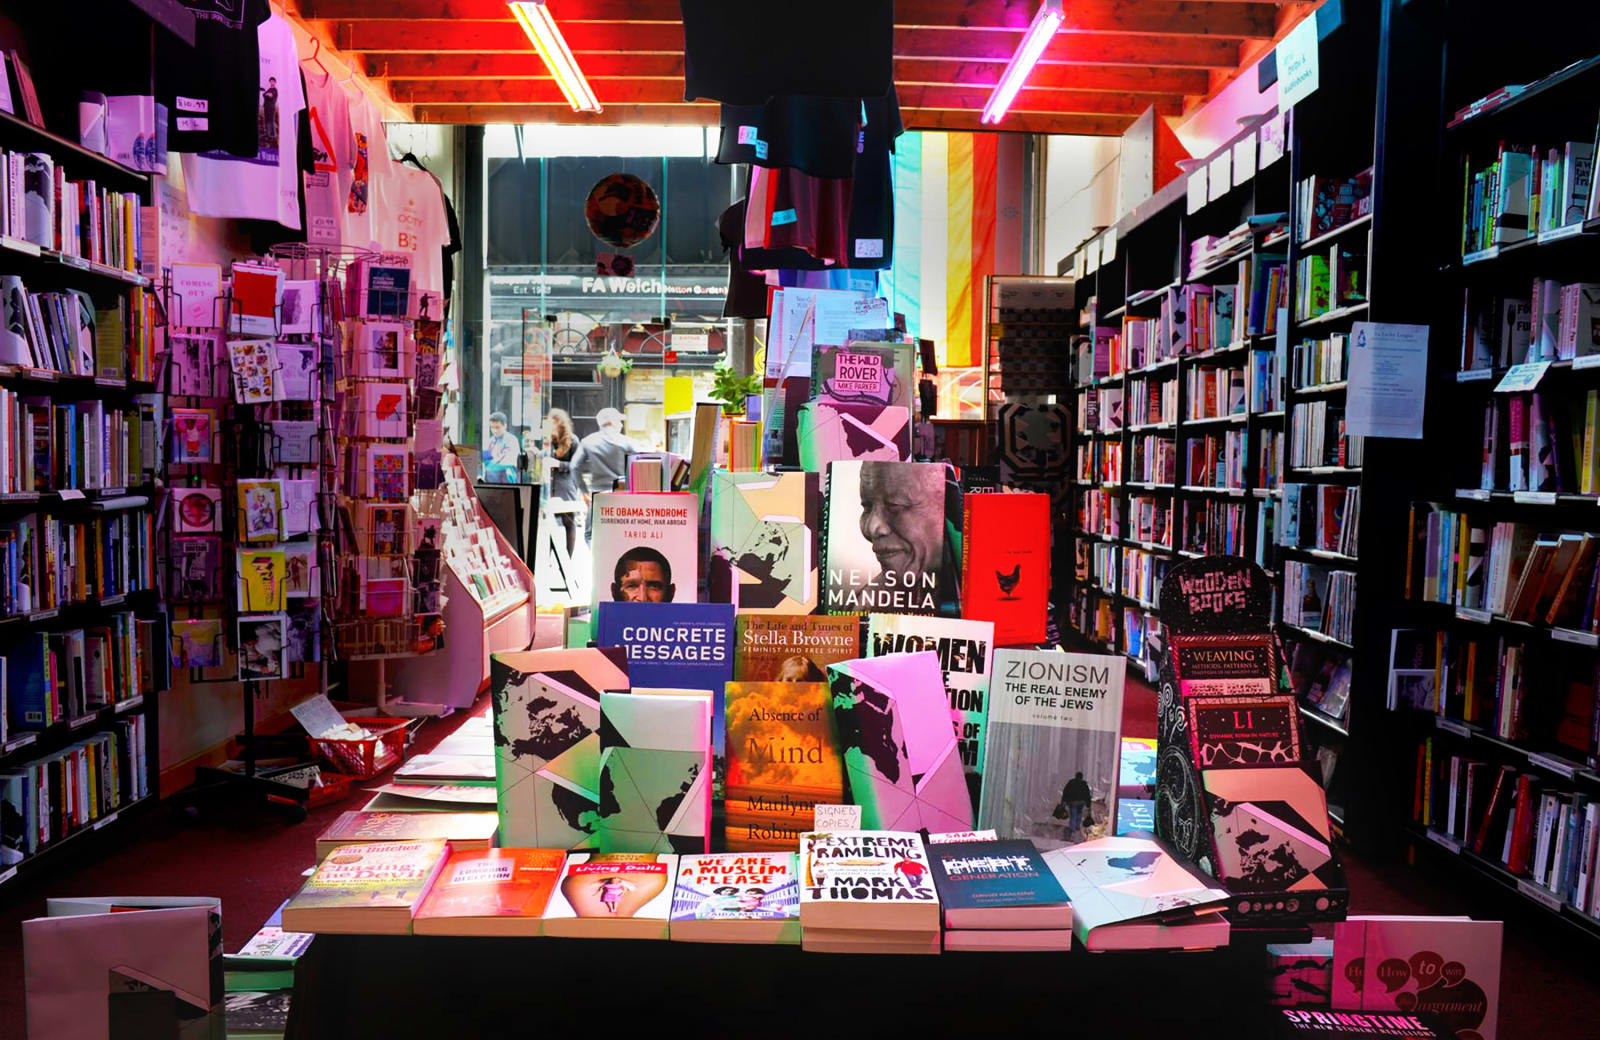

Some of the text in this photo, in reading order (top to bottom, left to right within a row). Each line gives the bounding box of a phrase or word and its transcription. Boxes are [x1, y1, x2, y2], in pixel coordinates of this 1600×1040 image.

[582, 277, 606, 293] FA
[609, 277, 662, 294] Welch
[838, 353, 879, 366] THE WILD
[839, 366, 877, 381] ROVER
[837, 382, 878, 391] MIKE PARKER
[600, 506, 688, 518] THE OBAMA SYNDROME
[624, 530, 663, 539] TARIQ ALI
[829, 569, 936, 589] NELSON
[1179, 569, 1252, 595] WOODEN
[828, 589, 936, 609] MANDELA
[1188, 591, 1246, 614] BOOKS
[745, 621, 765, 630] The
[791, 621, 807, 631] and
[811, 621, 841, 631] Times
[843, 623, 854, 631] of
[623, 627, 726, 643] CONCRETE
[743, 630, 854, 646] Stella Browne
[1193, 649, 1255, 662] WEAVING
[1006, 660, 1109, 685] ZIONISM
[1005, 682, 1107, 699] THE REAL ENEMY
[1015, 695, 1094, 711] OF THE JEWS
[748, 707, 823, 722] Absence of
[1032, 713, 1057, 721] volume
[1232, 710, 1254, 729] LI
[963, 722, 980, 740] OF
[747, 736, 824, 765] Mind
[816, 806, 857, 817] SIGNED
[815, 816, 858, 829] COPIES!
[366, 844, 423, 853] Butcher
[826, 836, 917, 848] EXTREME
[817, 847, 922, 860] RAMBLING
[319, 863, 416, 873] Chasing
[575, 864, 663, 873] Living Dolls
[697, 857, 772, 867] WE ARE
[316, 869, 425, 880] the Devil
[681, 868, 694, 876] A
[948, 871, 1040, 881] GENERATION
[696, 875, 773, 885] PLEASE
[834, 876, 904, 888] MARK
[805, 887, 934, 900] THOMAS
[1380, 965, 1408, 977] How
[1419, 960, 1436, 975] to
[1419, 1000, 1484, 1016] argument
[1282, 1009, 1430, 1031] SPRINGTIME
[1294, 1022, 1310, 1030] THE
[1335, 1025, 1377, 1034] STUDENT
